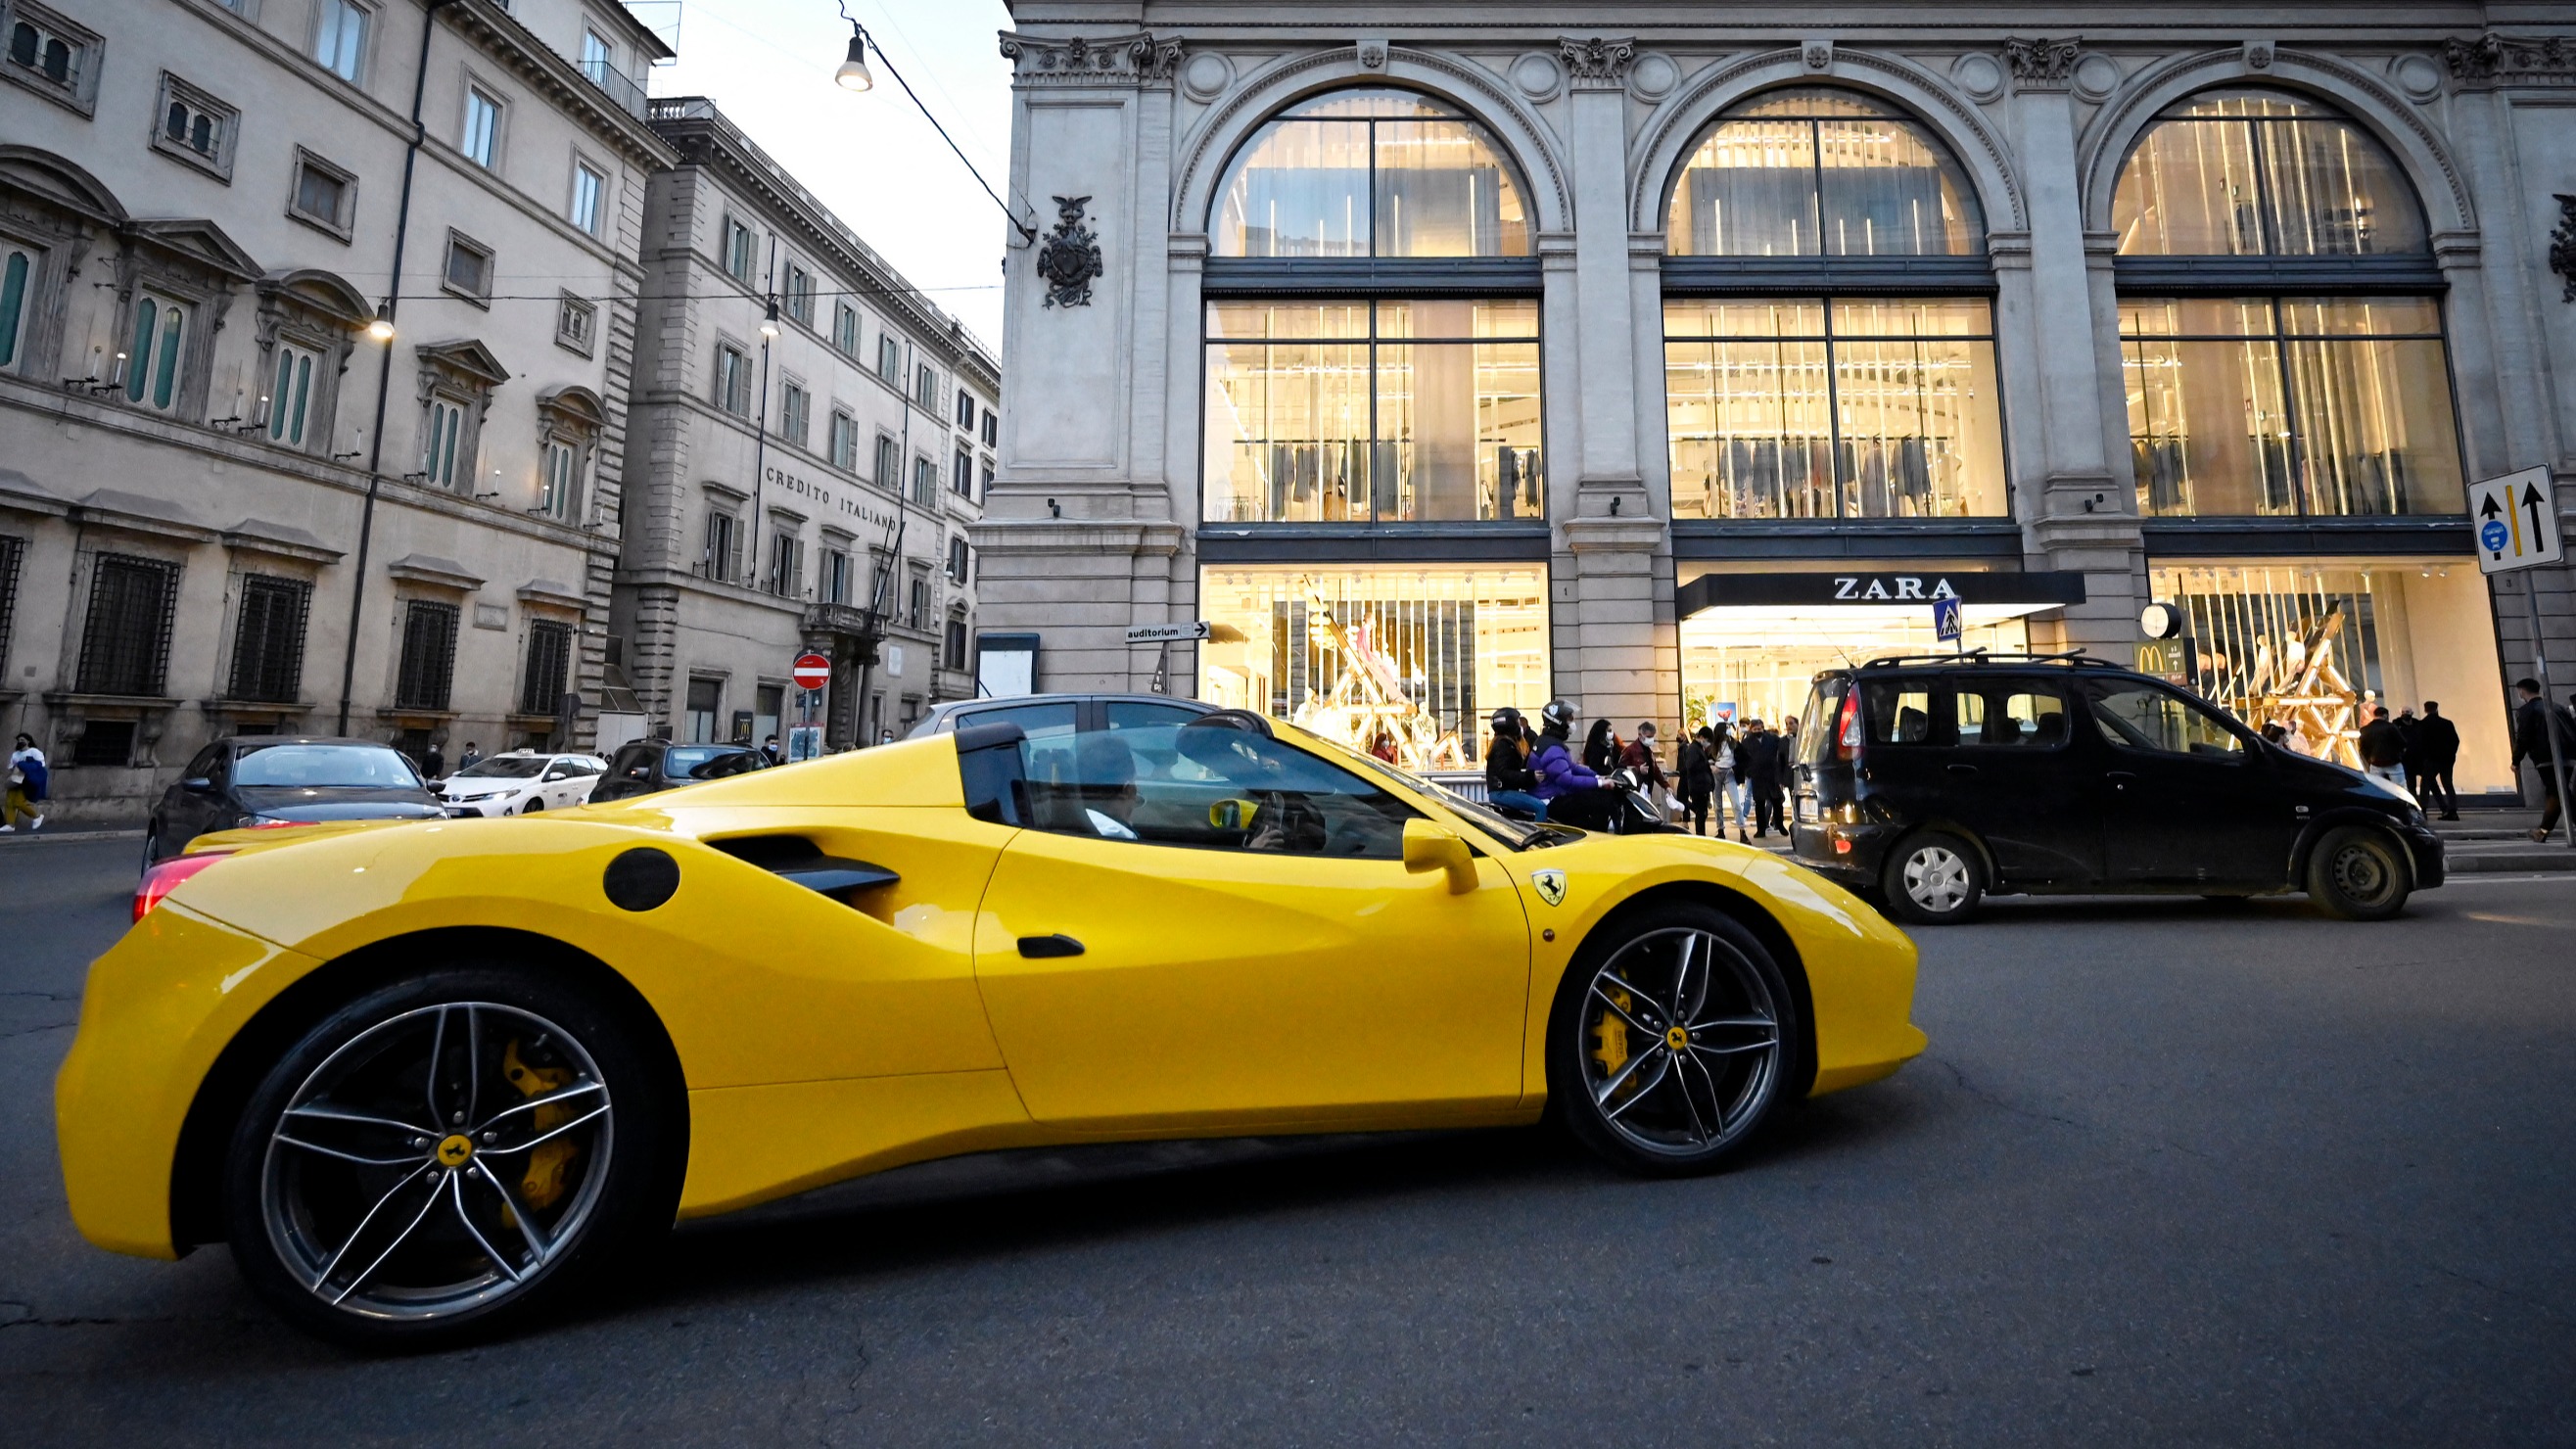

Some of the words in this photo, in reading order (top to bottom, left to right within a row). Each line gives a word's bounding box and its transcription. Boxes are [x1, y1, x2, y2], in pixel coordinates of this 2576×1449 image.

[767, 467, 830, 504] CREDITO
[840, 497, 897, 532] ITALIANO
[1834, 578, 1957, 599] ZARA
[1127, 628, 1179, 638] auditorium
